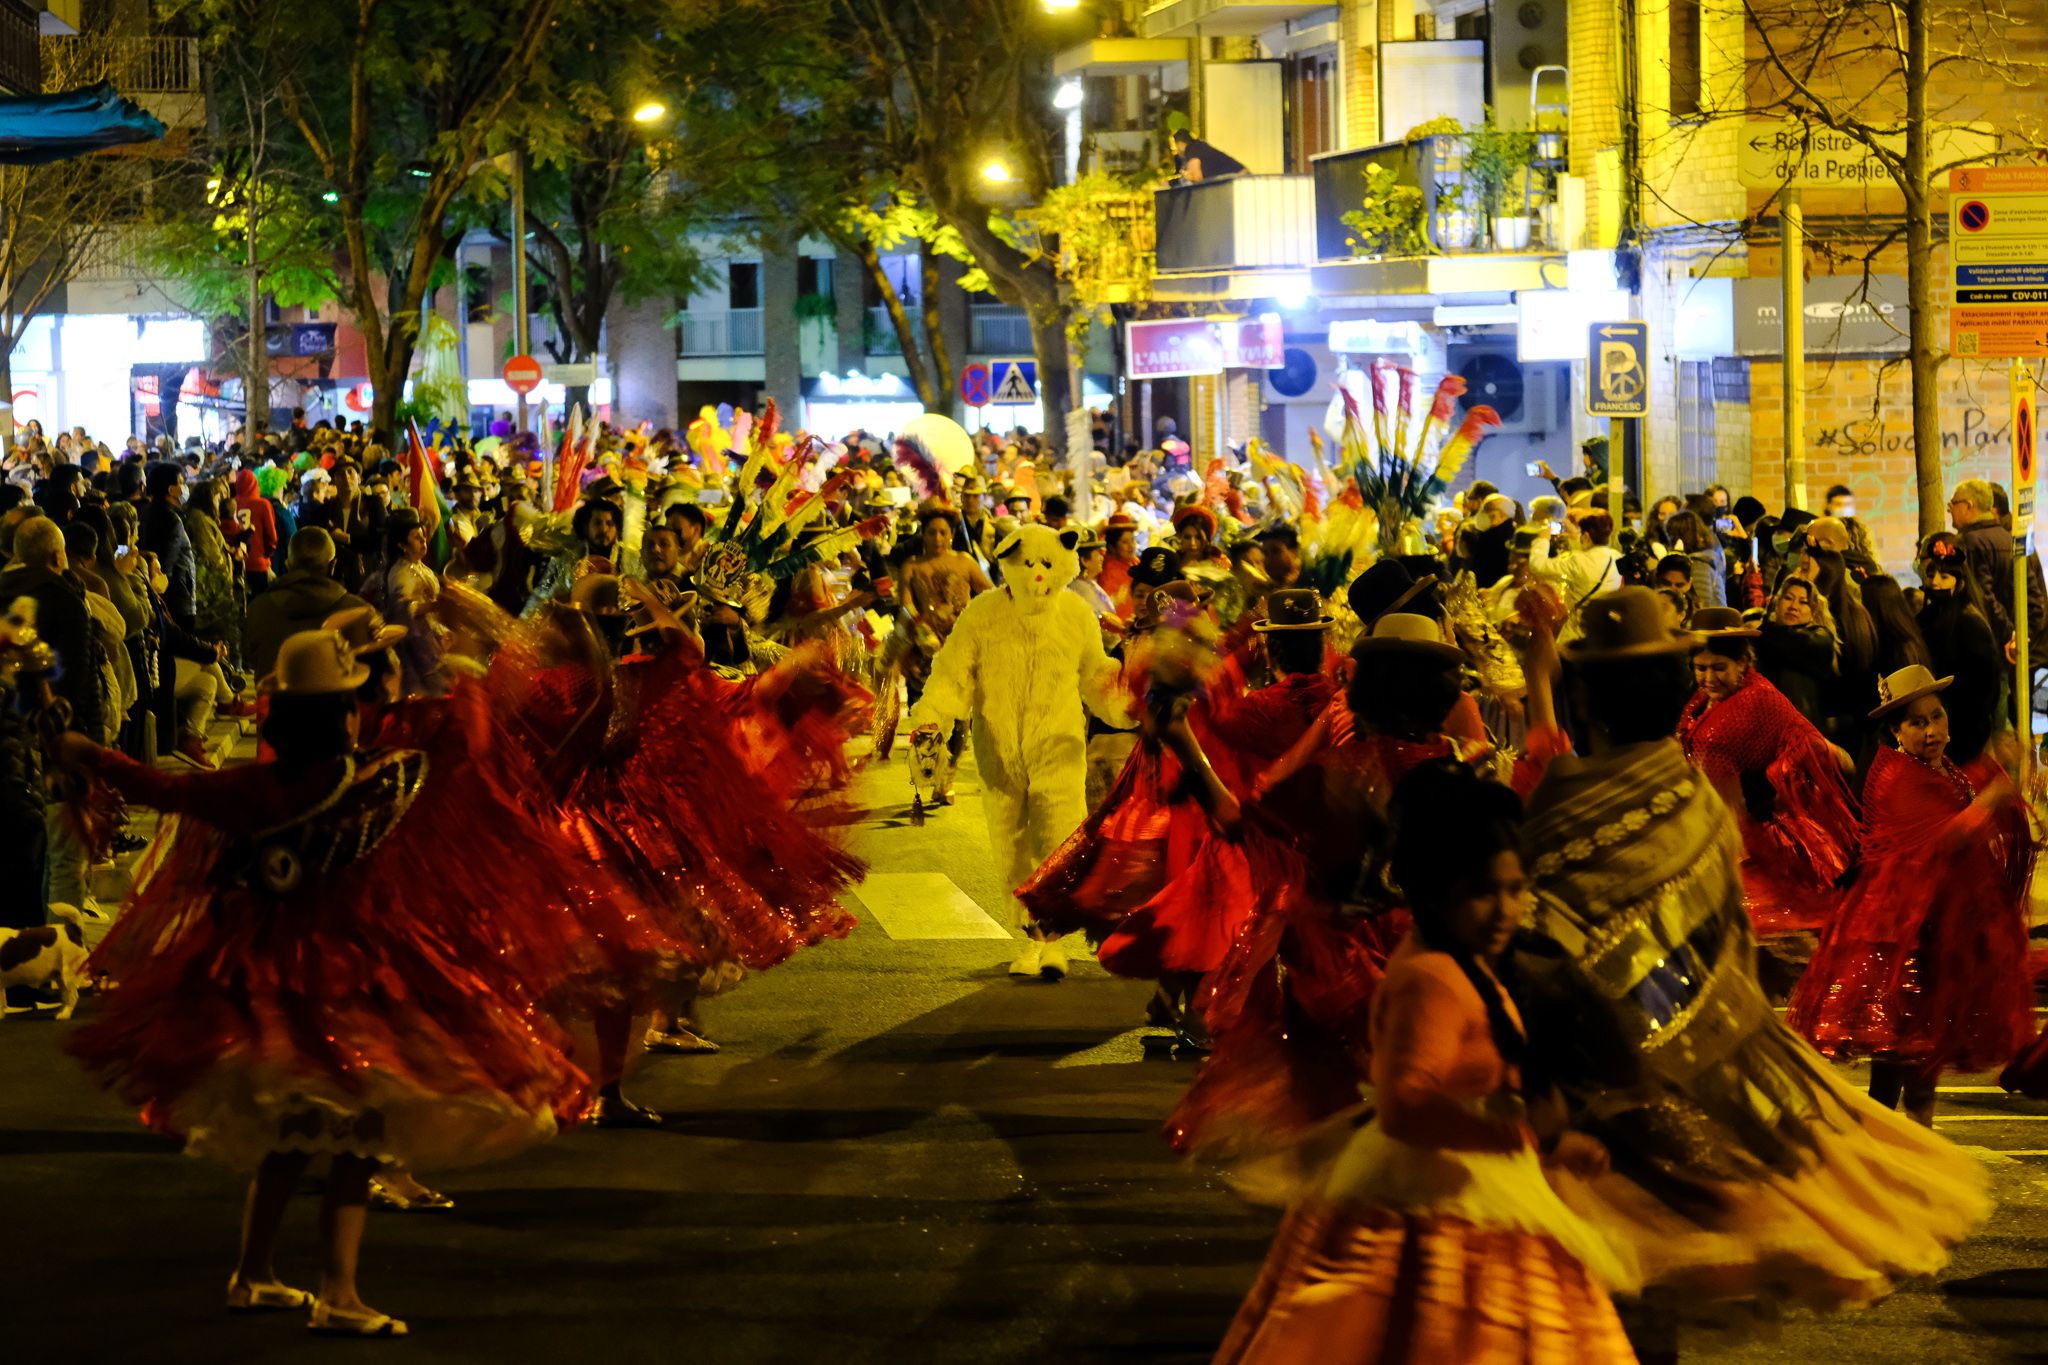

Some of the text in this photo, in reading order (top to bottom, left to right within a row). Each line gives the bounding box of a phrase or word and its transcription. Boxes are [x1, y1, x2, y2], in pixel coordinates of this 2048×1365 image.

[1776, 161, 1798, 179] de
[1804, 161, 1819, 179] la
[2012, 291, 2047, 300] CDV-011
[1594, 401, 1642, 411] FRANCESC
